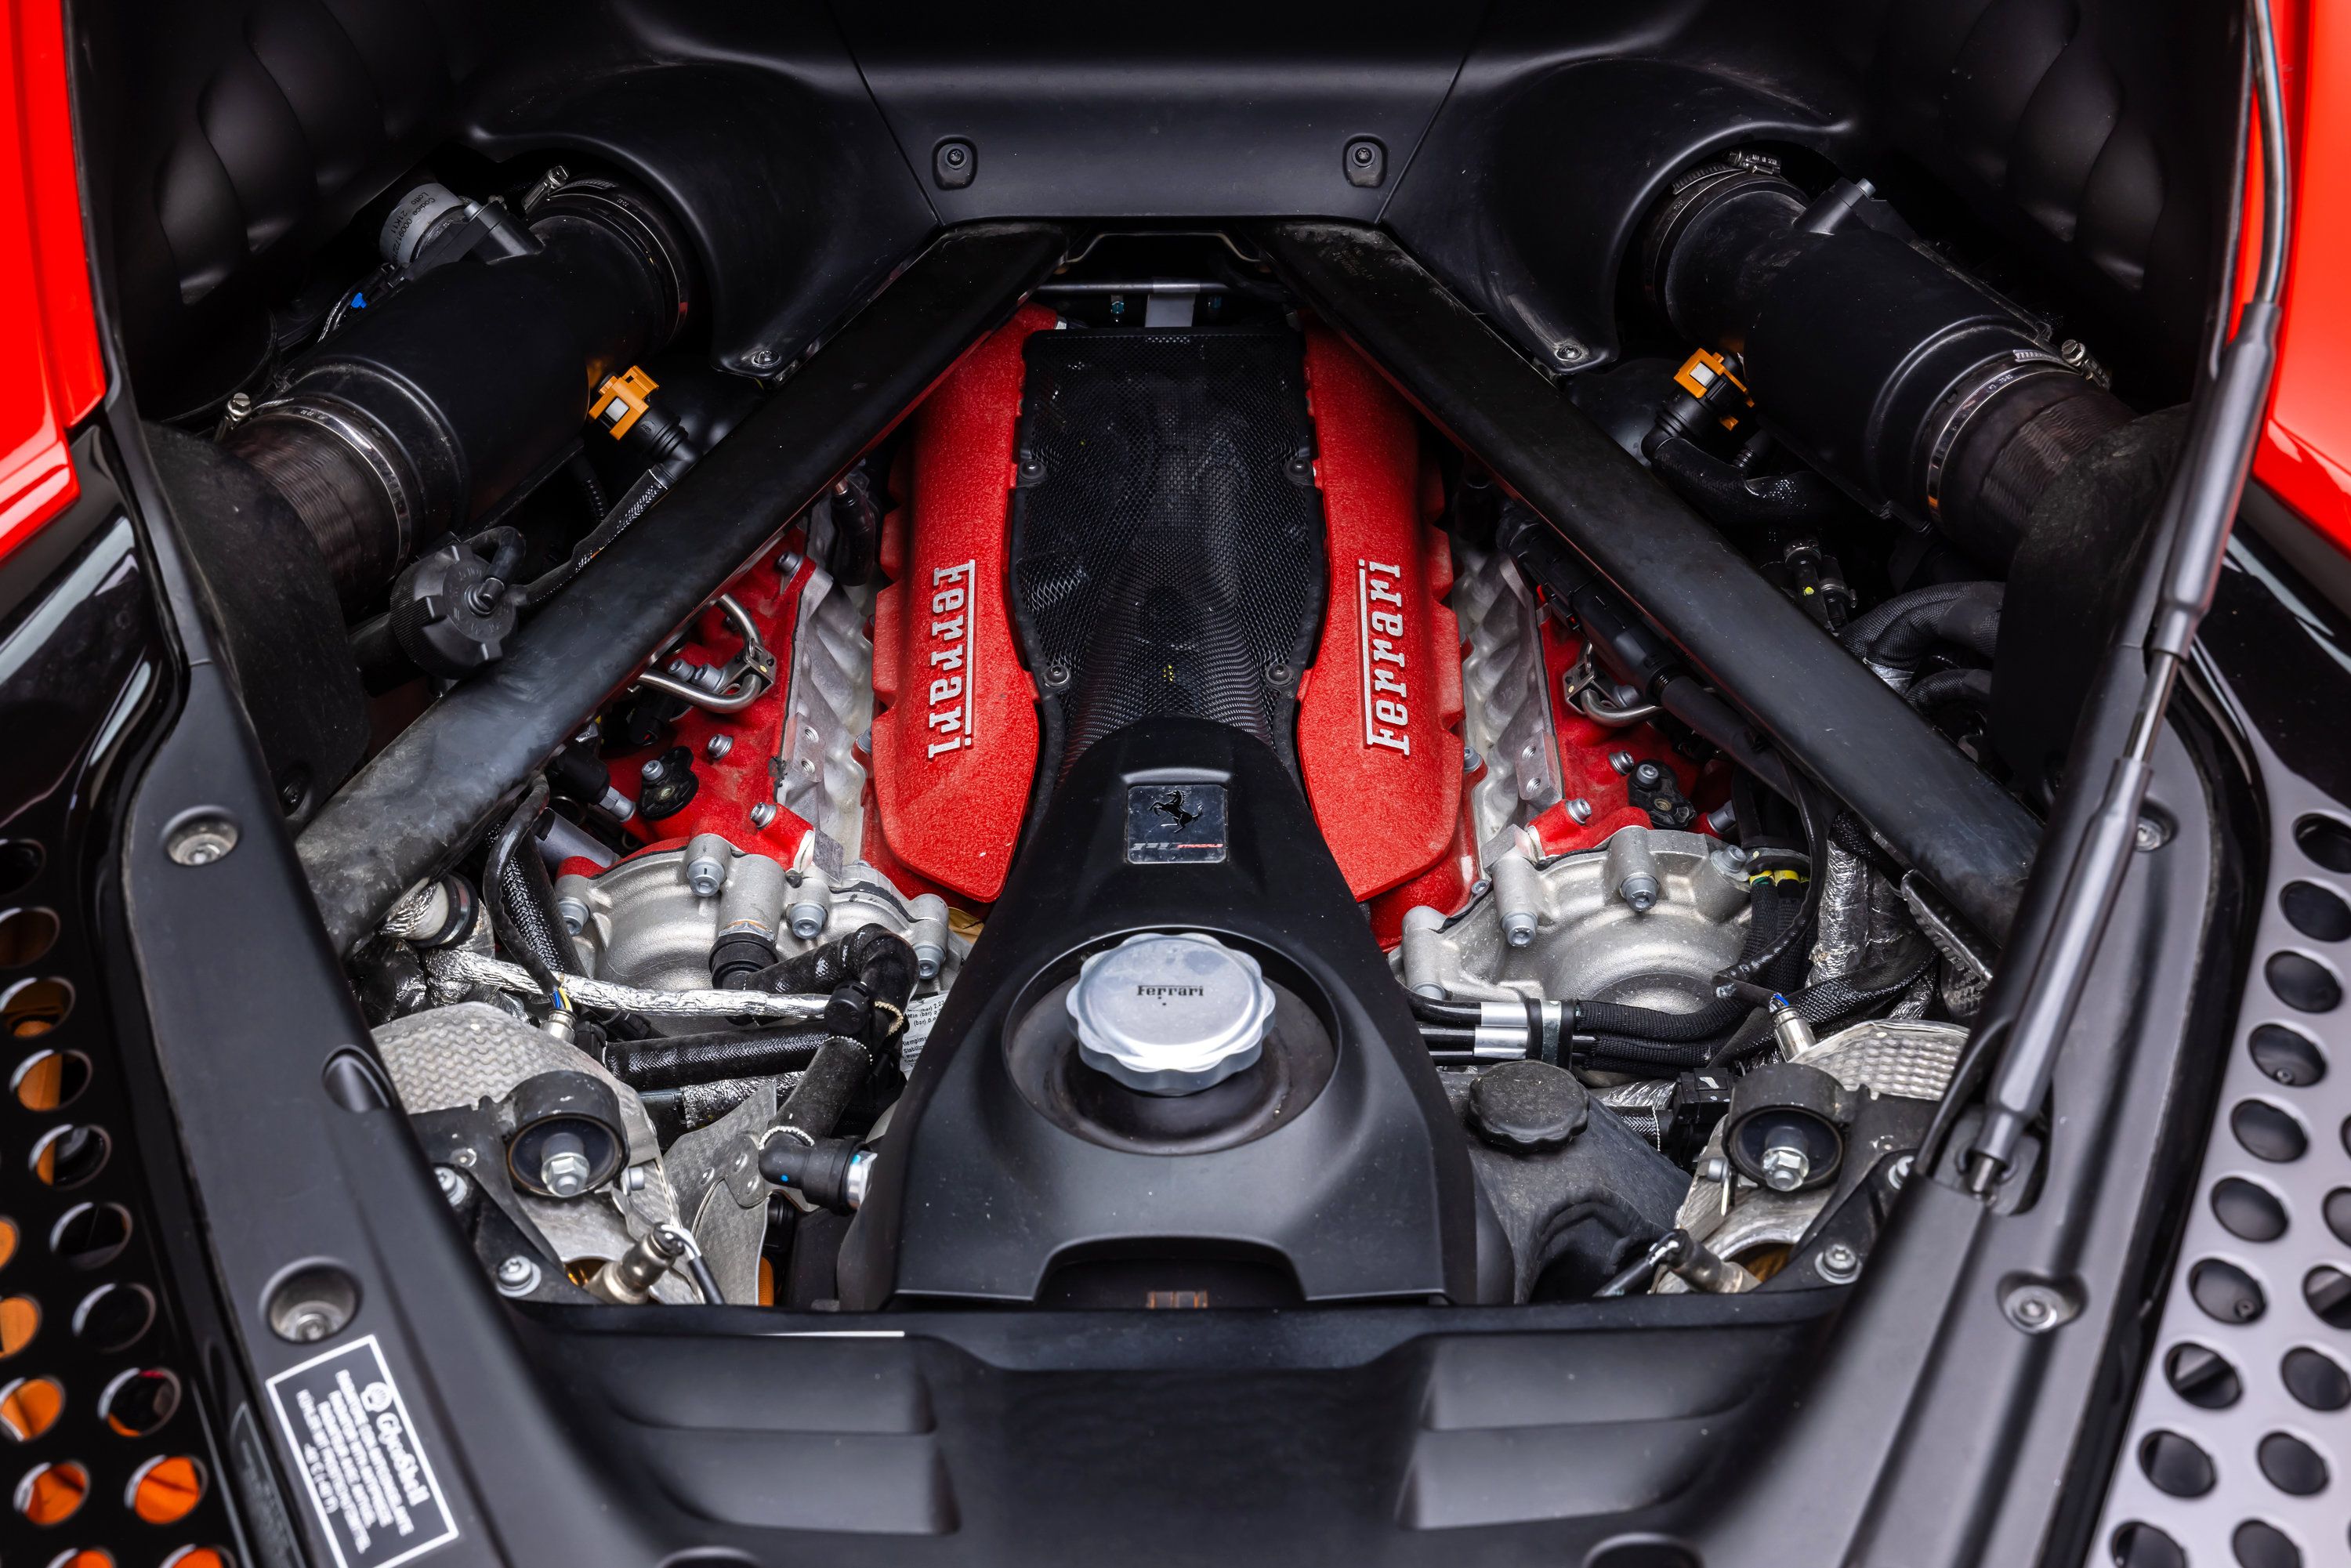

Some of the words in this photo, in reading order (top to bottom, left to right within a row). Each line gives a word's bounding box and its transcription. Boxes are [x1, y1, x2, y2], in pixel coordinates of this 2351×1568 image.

[411, 192, 429, 205] Lotto
[412, 197, 436, 215] Codice
[391, 210, 408, 234] 21K11
[928, 559, 976, 759] Ferrari
[1359, 559, 1410, 755] Ferrari
[1137, 985, 1204, 996] Ferrari
